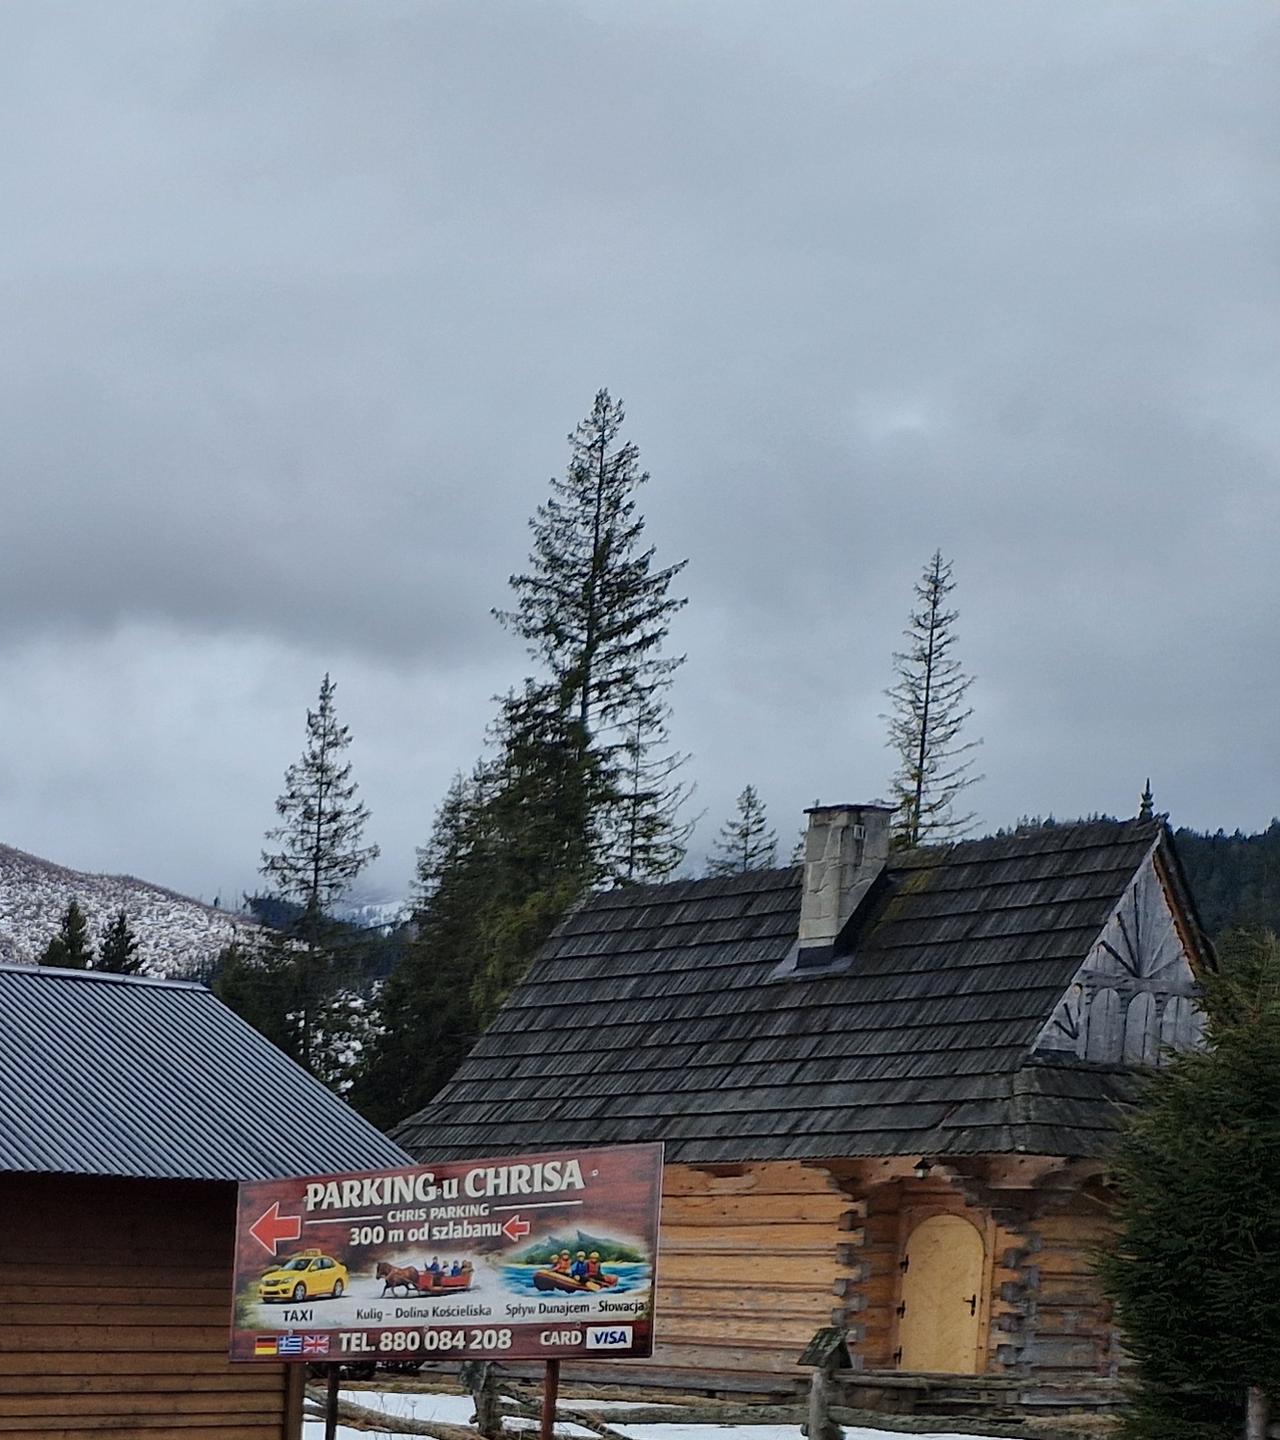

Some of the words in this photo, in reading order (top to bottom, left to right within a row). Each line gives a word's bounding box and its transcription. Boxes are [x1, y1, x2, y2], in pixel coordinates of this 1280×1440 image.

[306, 1173, 437, 1212] PARKING
[442, 1178, 459, 1200] u
[464, 1159, 585, 1198] CHRISA
[387, 1208, 427, 1223] CHRIS
[430, 1203, 490, 1220] PARKING
[349, 1225, 385, 1246] 300
[387, 1229, 405, 1243] m
[407, 1222, 429, 1241] od
[432, 1219, 502, 1241] szlabanu
[283, 1309, 313, 1322] TAXI
[356, 1308, 383, 1322] Kulig
[395, 1306, 429, 1319] Dolina
[432, 1303, 492, 1318] Kościeliska
[505, 1303, 536, 1318] Spływ
[539, 1302, 590, 1316] Dunajcem
[598, 1299, 645, 1314] Słowacja
[339, 1332, 376, 1353] TEL.
[379, 1331, 420, 1352] 880
[424, 1329, 466, 1351] 084
[469, 1328, 512, 1350] 208
[540, 1330, 582, 1346] CARD
[594, 1331, 628, 1345] VISA
